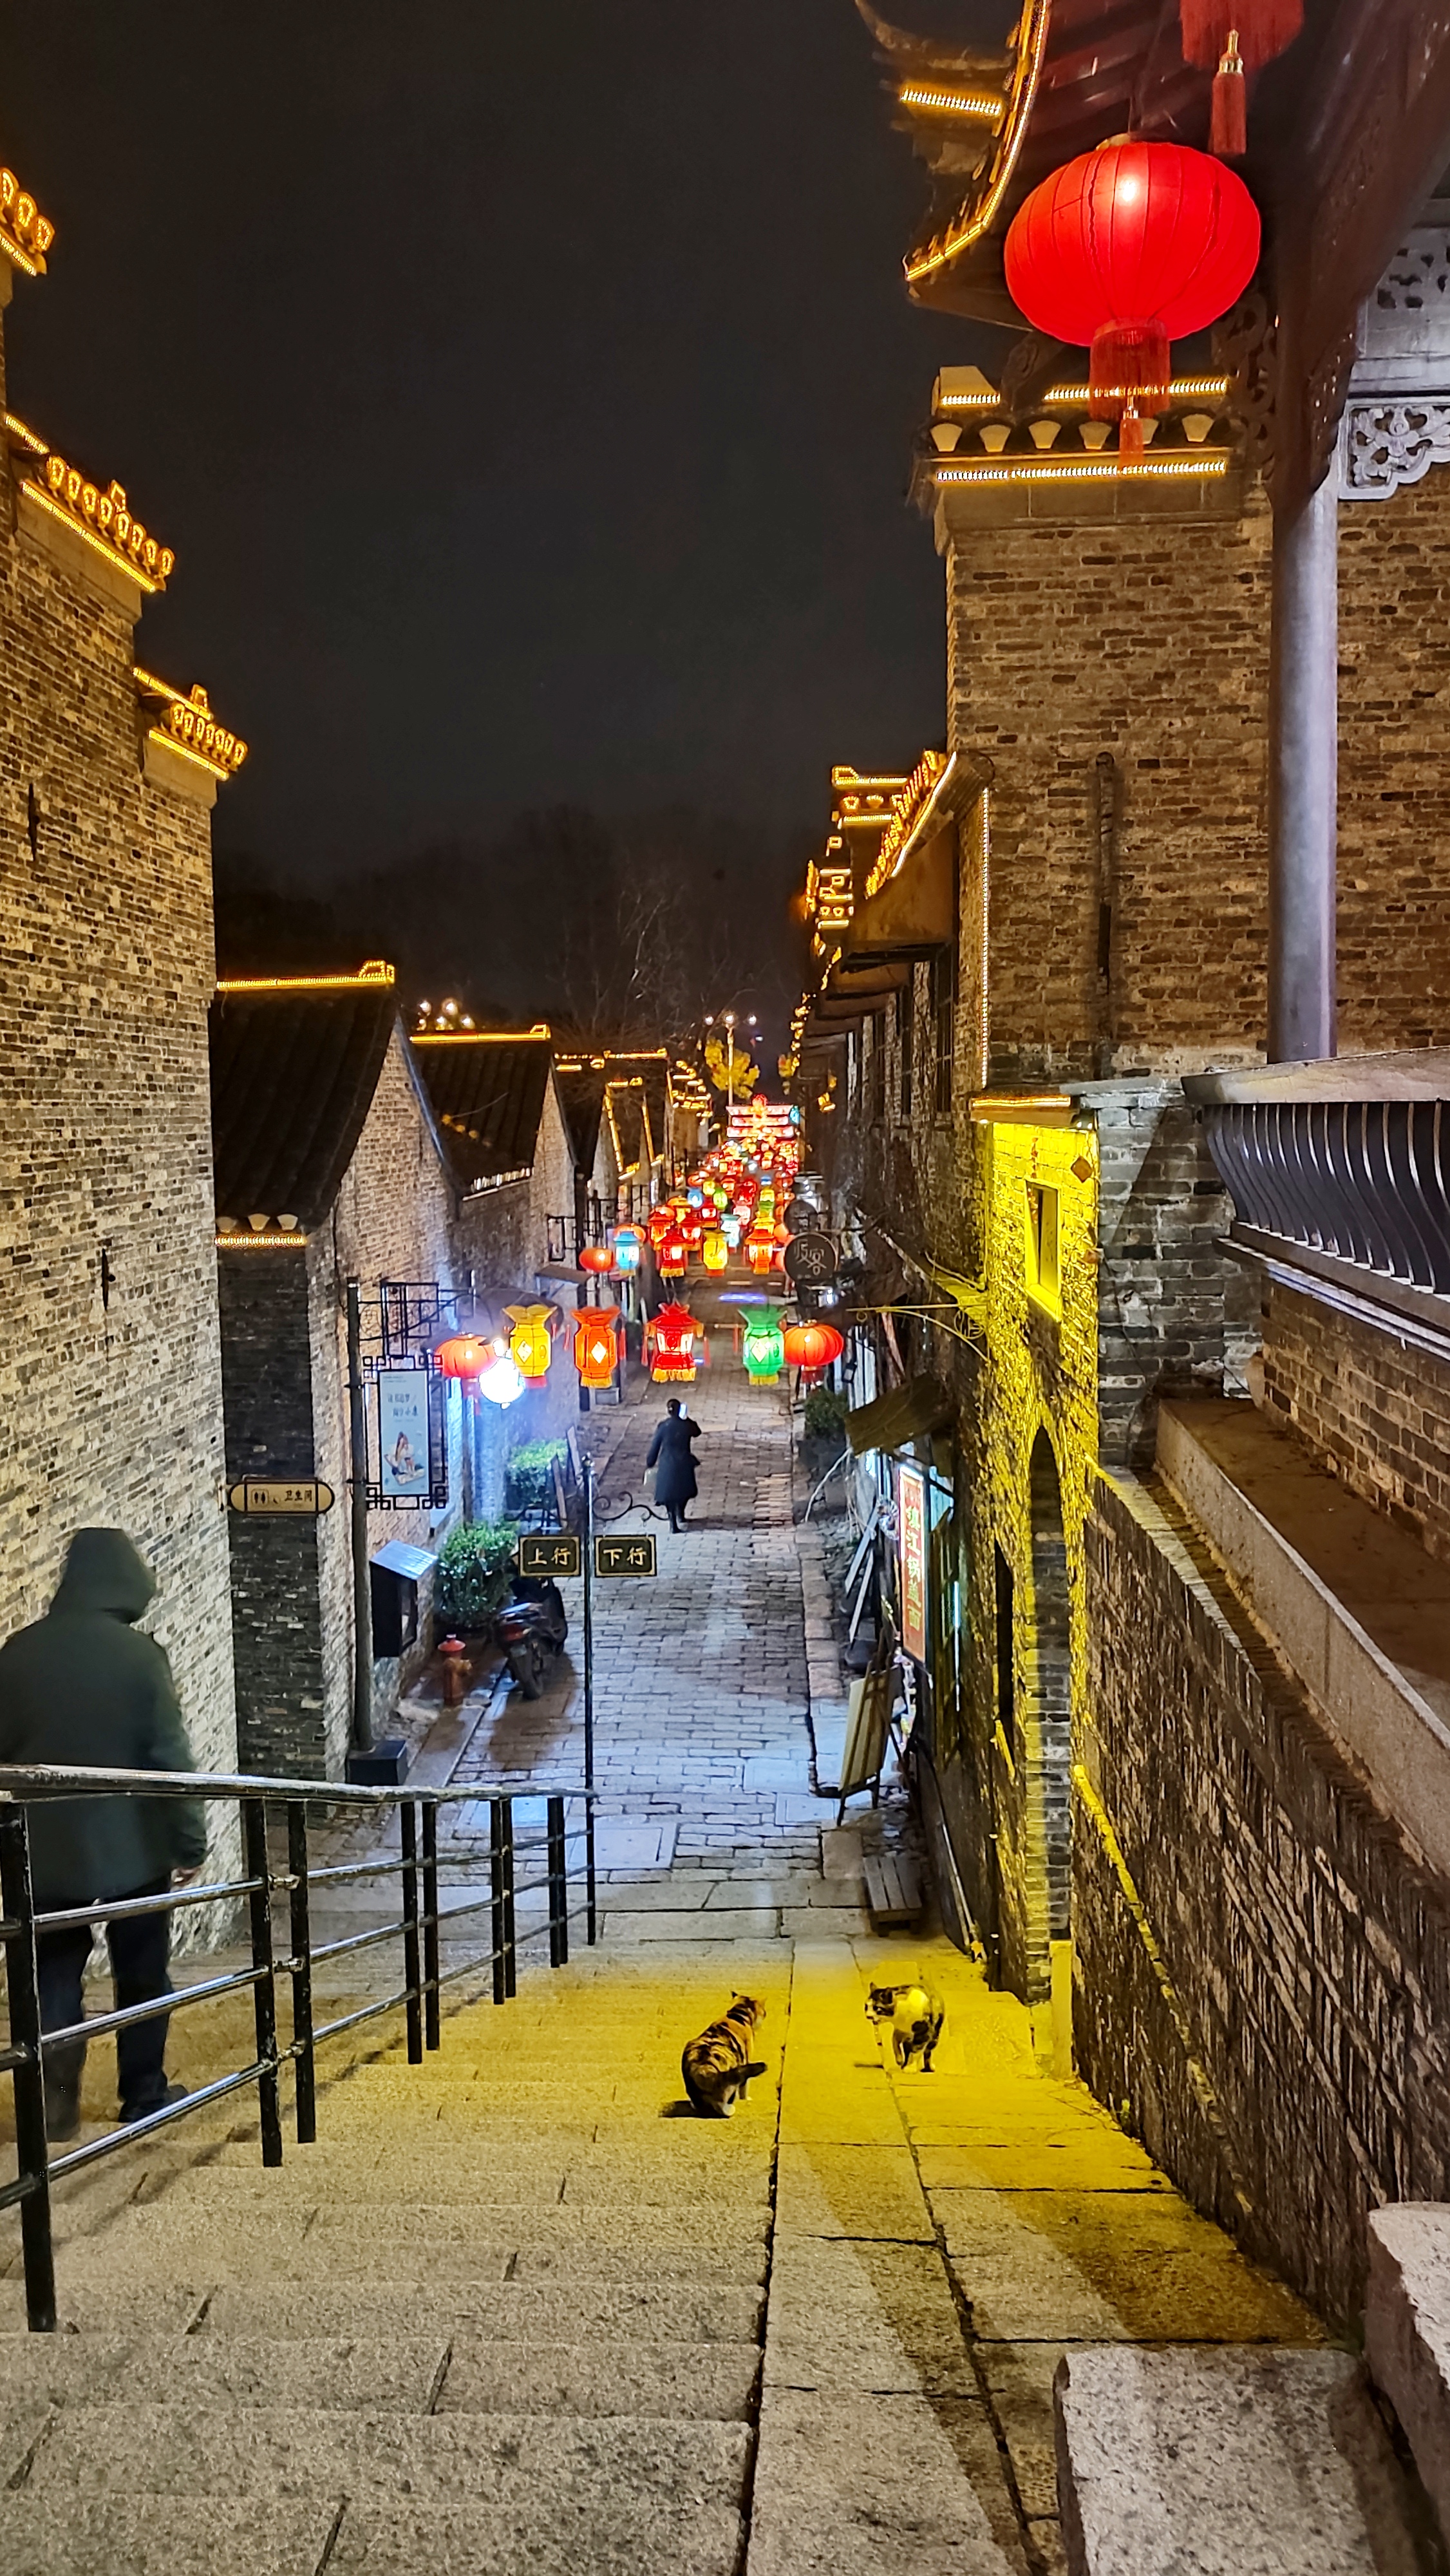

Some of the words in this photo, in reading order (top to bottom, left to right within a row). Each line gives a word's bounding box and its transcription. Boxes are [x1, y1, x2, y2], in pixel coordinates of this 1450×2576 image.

[284, 1490, 312, 1502] 卫生间
[528, 1547, 571, 1566] 上行
[603, 1547, 646, 1566] 下行
